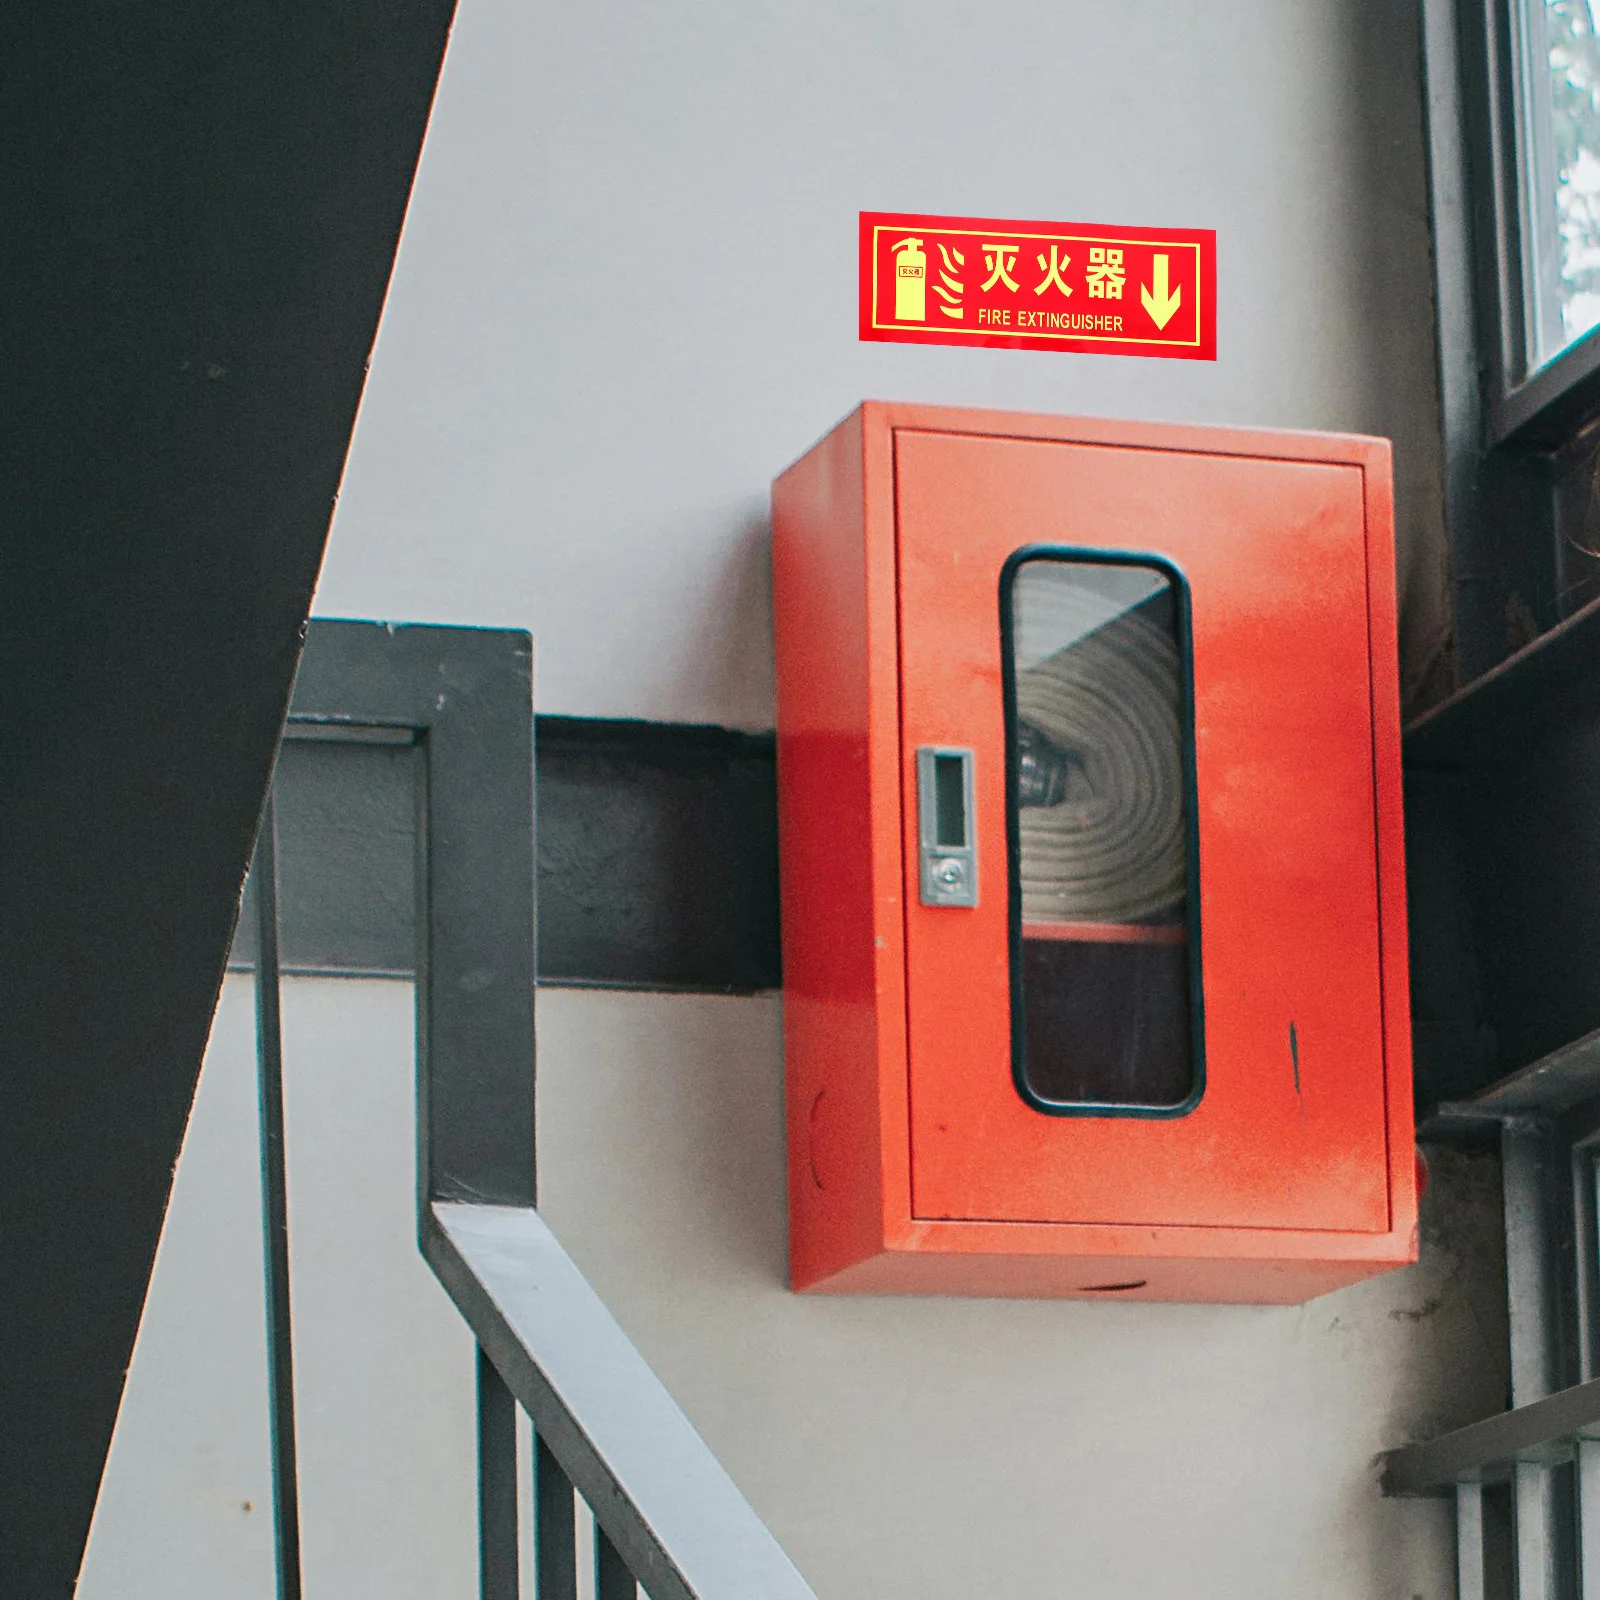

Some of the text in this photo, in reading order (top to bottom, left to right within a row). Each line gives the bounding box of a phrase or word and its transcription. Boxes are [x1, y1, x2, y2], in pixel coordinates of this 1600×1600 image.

[980, 243, 1127, 300] 灭火器
[978, 308, 1123, 332] FIRE EXTINGUISHER
